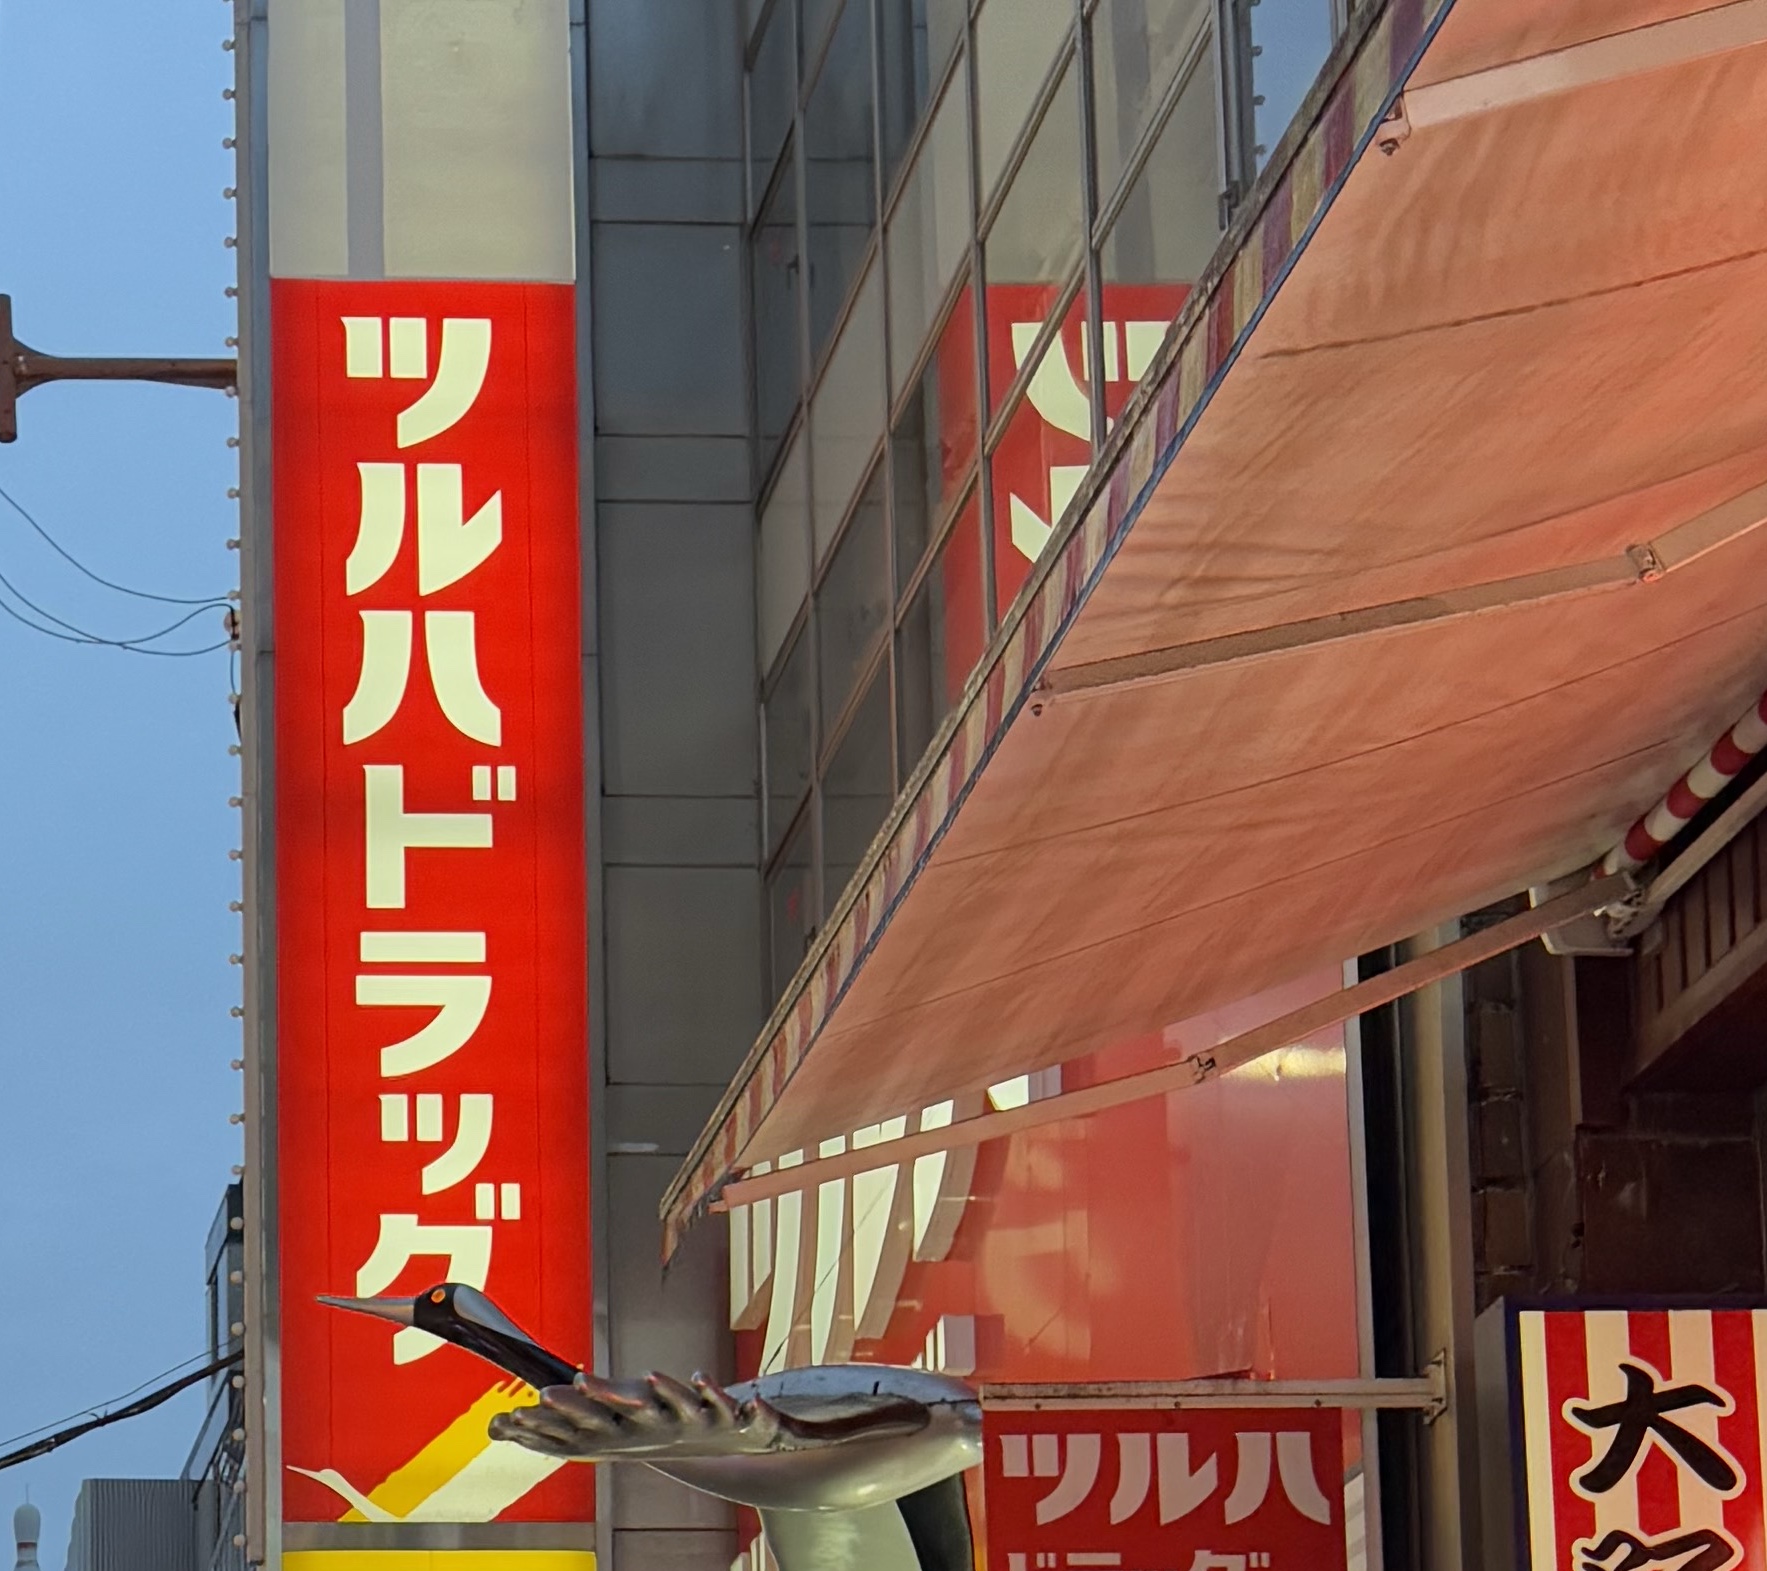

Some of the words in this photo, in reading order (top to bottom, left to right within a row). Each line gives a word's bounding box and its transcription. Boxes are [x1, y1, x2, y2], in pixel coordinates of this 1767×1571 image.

[340, 316, 521, 1366] ツルハドラッグ
[1000, 1431, 1331, 1526] ツルハ
